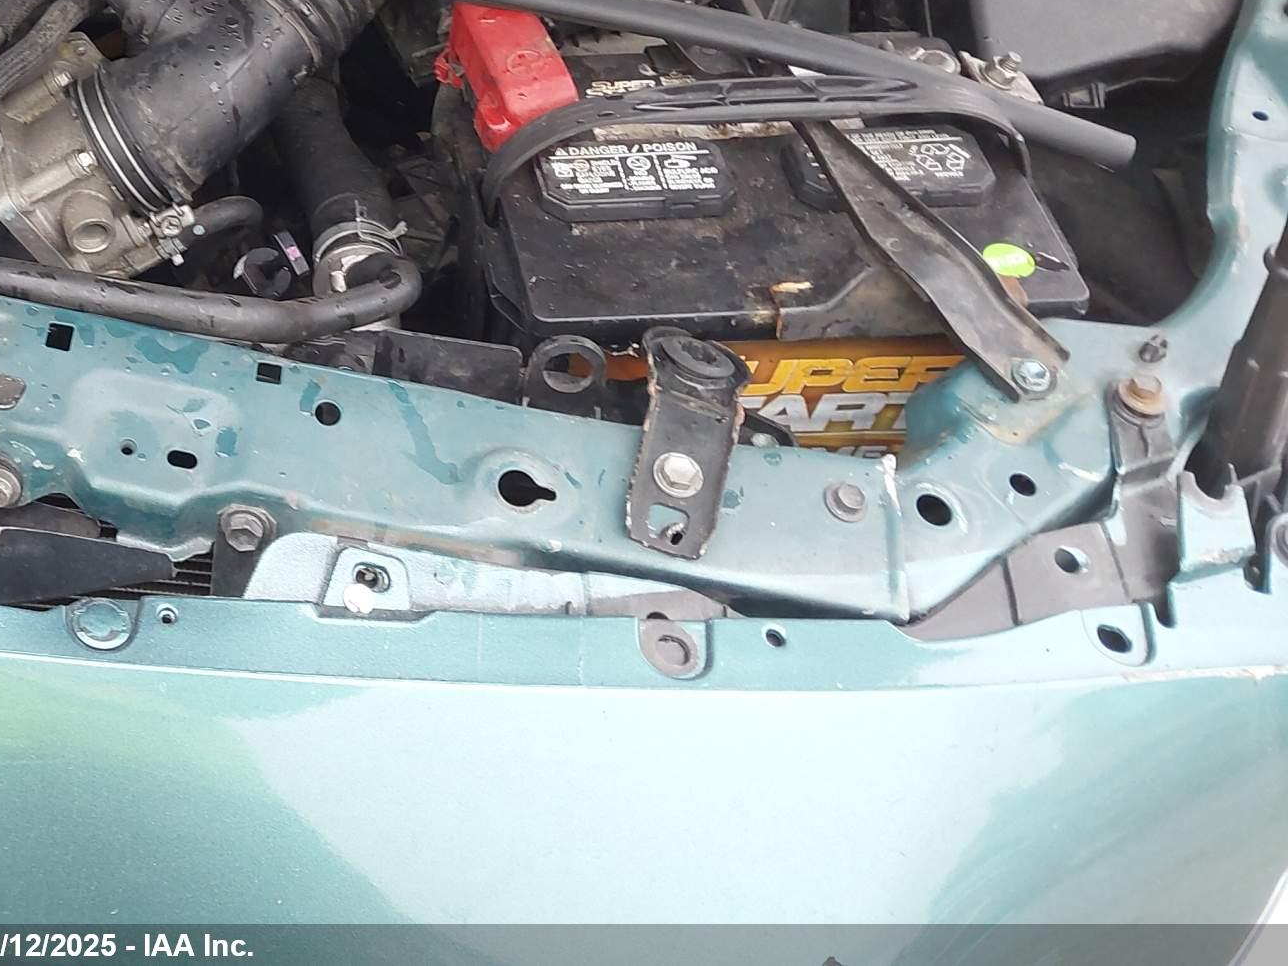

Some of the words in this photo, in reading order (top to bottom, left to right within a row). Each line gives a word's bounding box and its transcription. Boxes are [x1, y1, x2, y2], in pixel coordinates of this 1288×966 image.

[568, 144, 629, 155] DANGER
[642, 141, 697, 152] POISON
[741, 355, 964, 394] UPER
